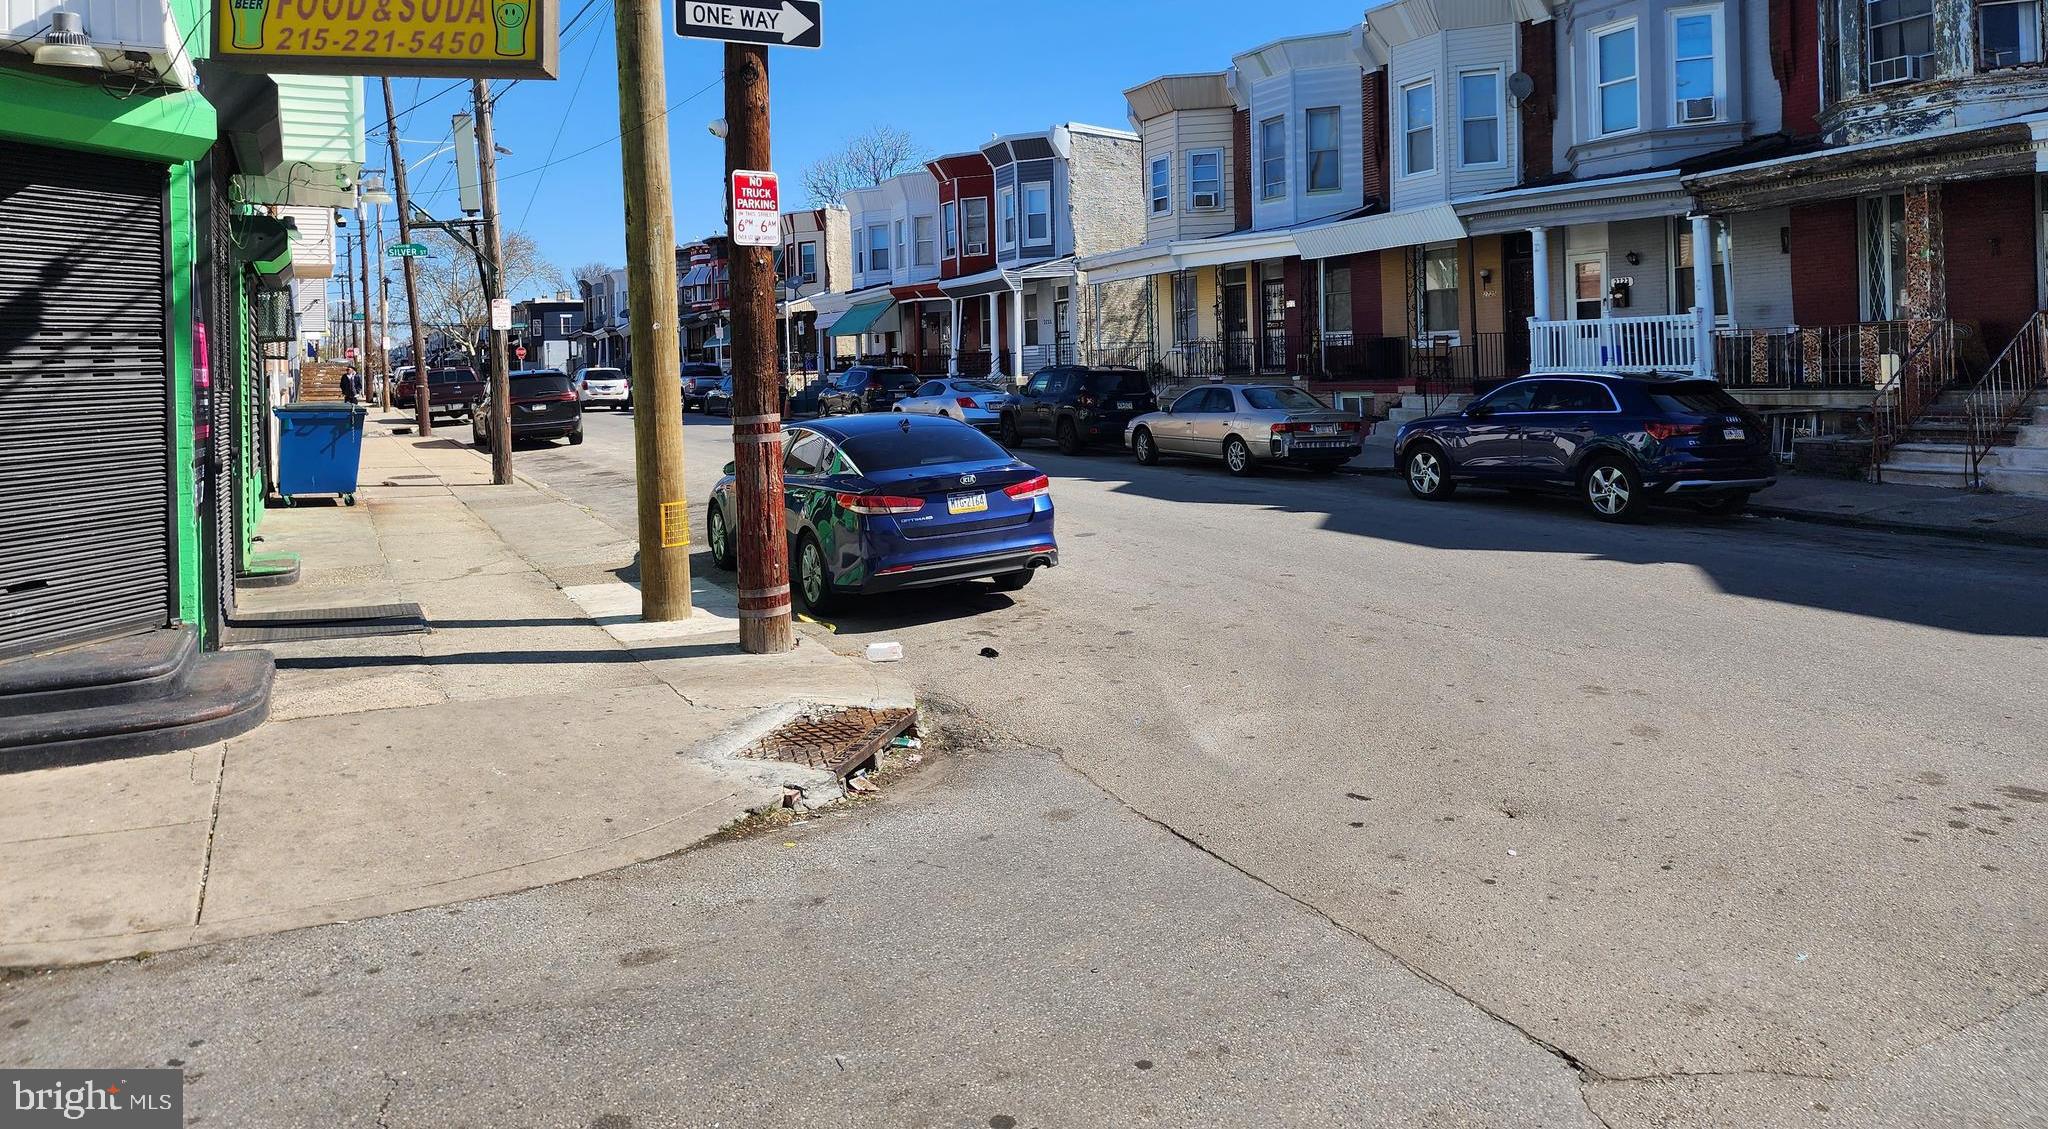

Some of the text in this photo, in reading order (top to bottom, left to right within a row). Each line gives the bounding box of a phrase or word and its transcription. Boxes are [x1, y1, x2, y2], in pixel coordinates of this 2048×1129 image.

[234, 0, 263, 9] BEER
[693, 5, 779, 29] ONE WAY
[276, 27, 485, 54] 215-221-5450
[749, 177, 762, 187] NO
[741, 188, 772, 198] TRUCK
[737, 199, 776, 209] PARKING
[389, 248, 417, 256] SILVER
